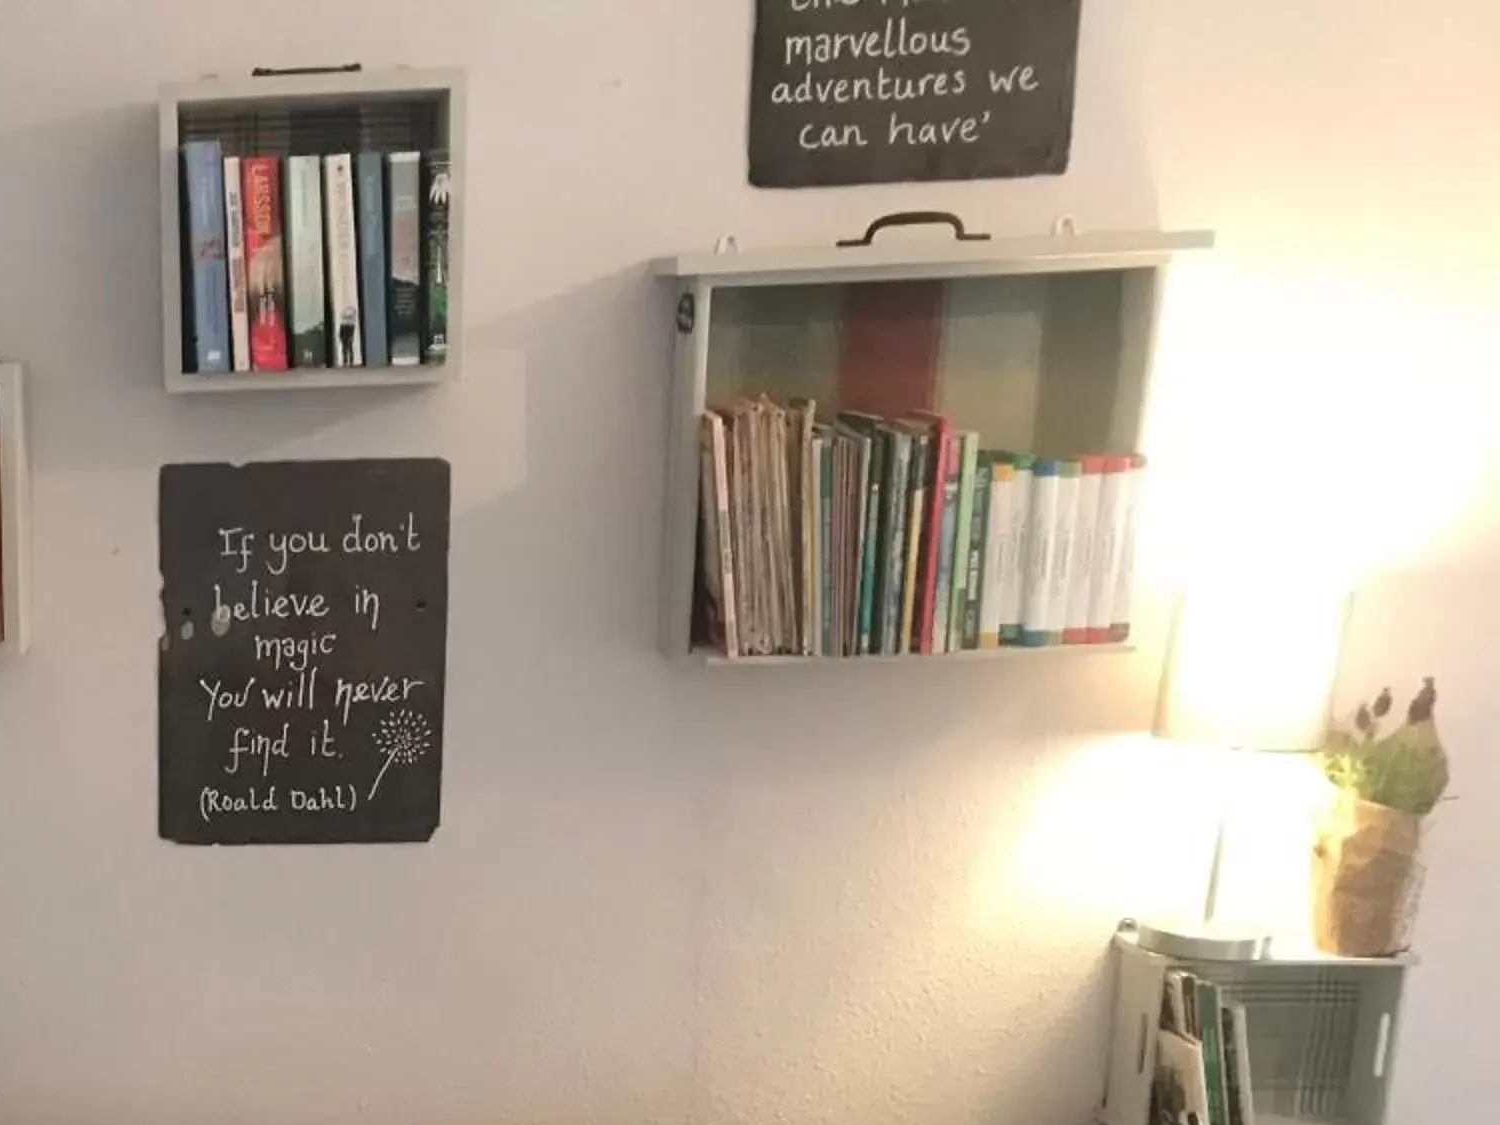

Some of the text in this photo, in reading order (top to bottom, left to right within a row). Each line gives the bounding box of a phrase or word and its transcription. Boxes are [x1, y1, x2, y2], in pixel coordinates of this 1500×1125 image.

[785, 18, 971, 64] marvellous
[771, 64, 1040, 103] adventures we
[799, 123, 868, 149] can
[218, 512, 421, 575] If you don't
[213, 580, 380, 631] believe in
[254, 631, 337, 672] magic
[200, 667, 425, 726] You will never
[224, 722, 291, 777] find
[200, 784, 357, 822] (Roald Dahl)
